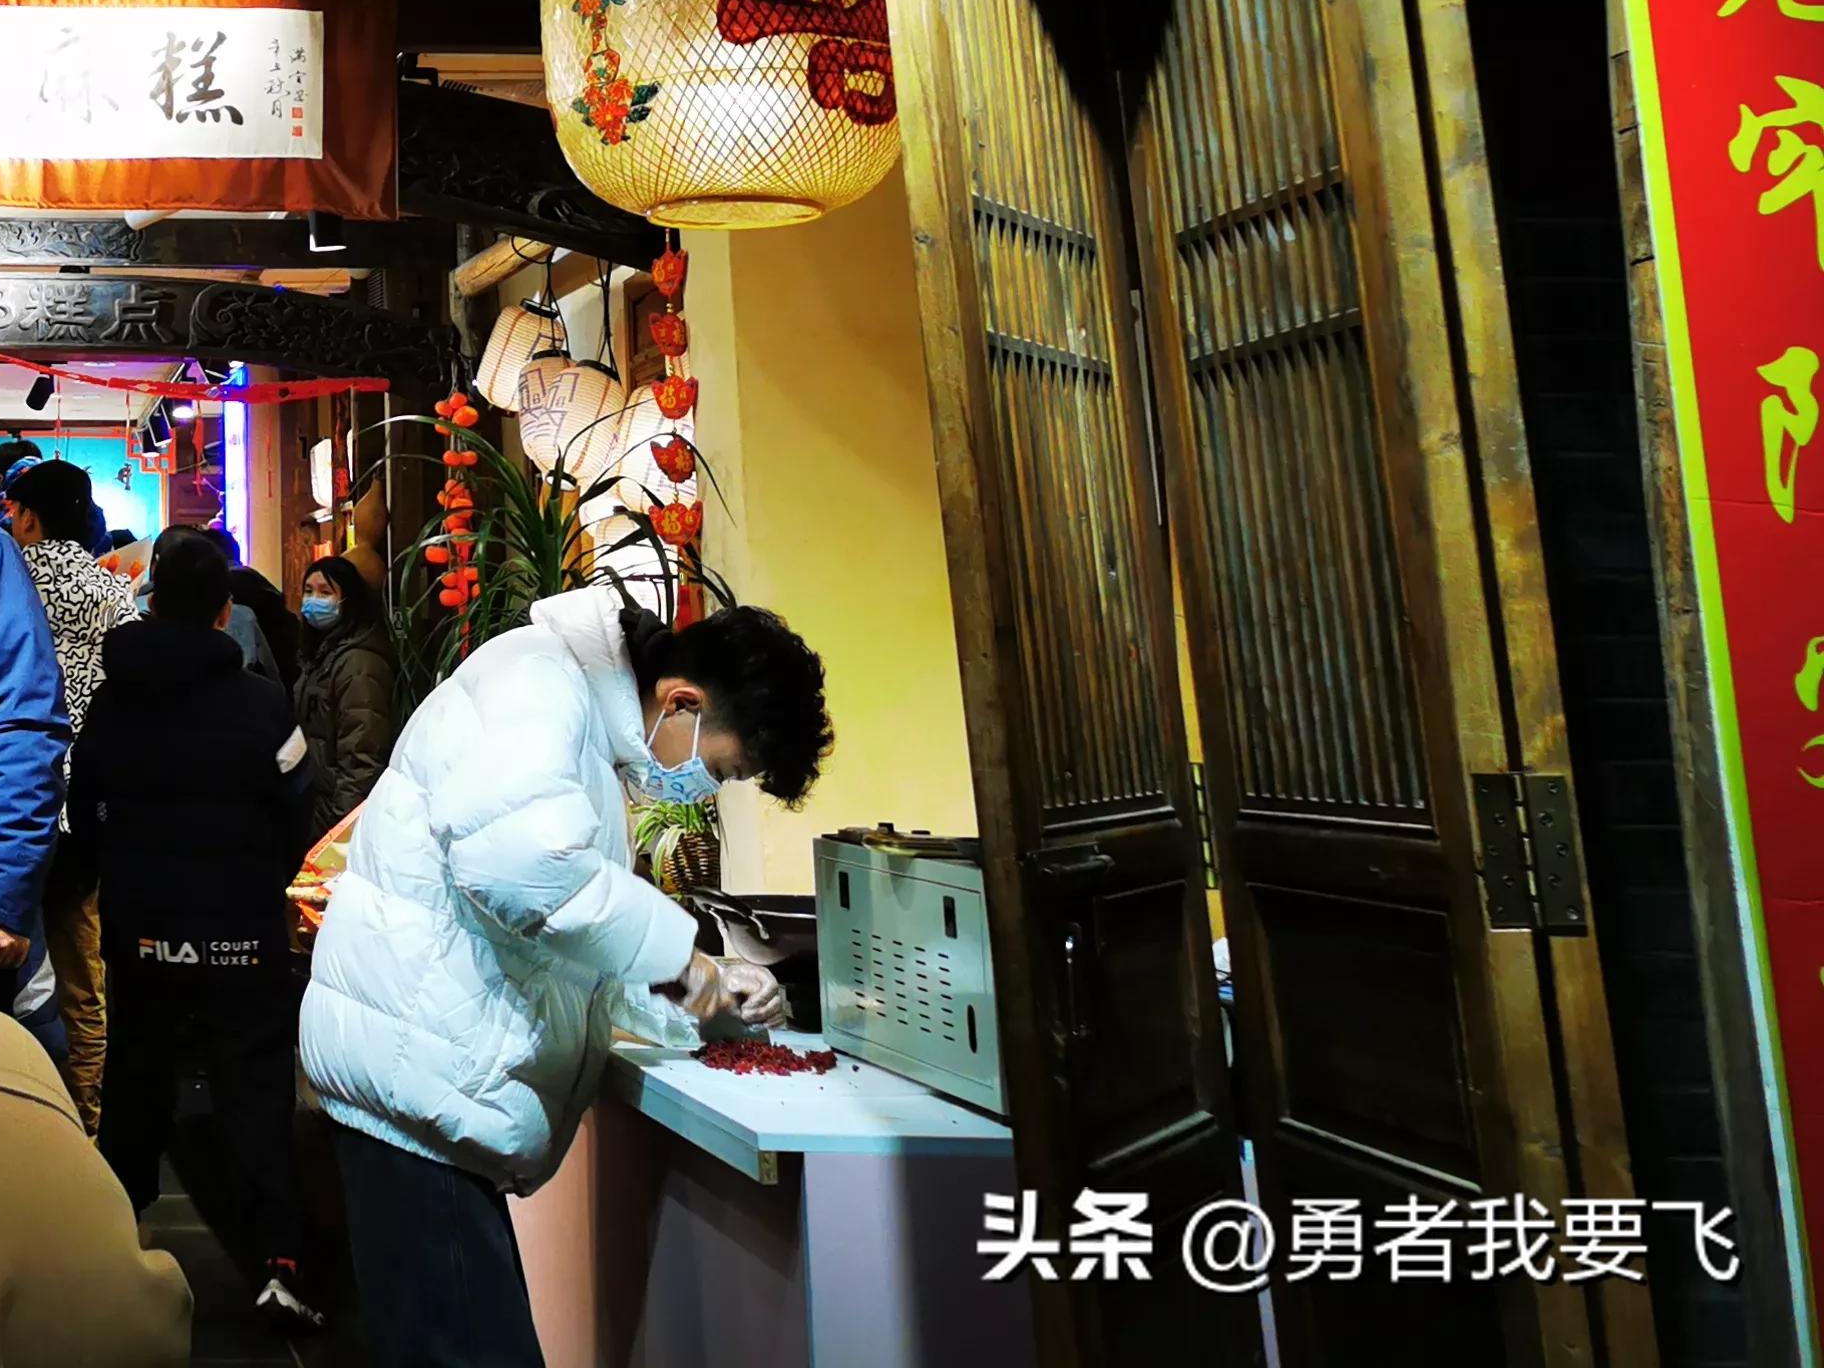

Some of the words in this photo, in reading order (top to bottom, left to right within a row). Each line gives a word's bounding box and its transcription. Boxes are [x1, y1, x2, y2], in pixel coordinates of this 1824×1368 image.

[138, 938, 199, 964] FILA
[210, 940, 260, 952] COURT
[211, 955, 249, 966] LUXE
